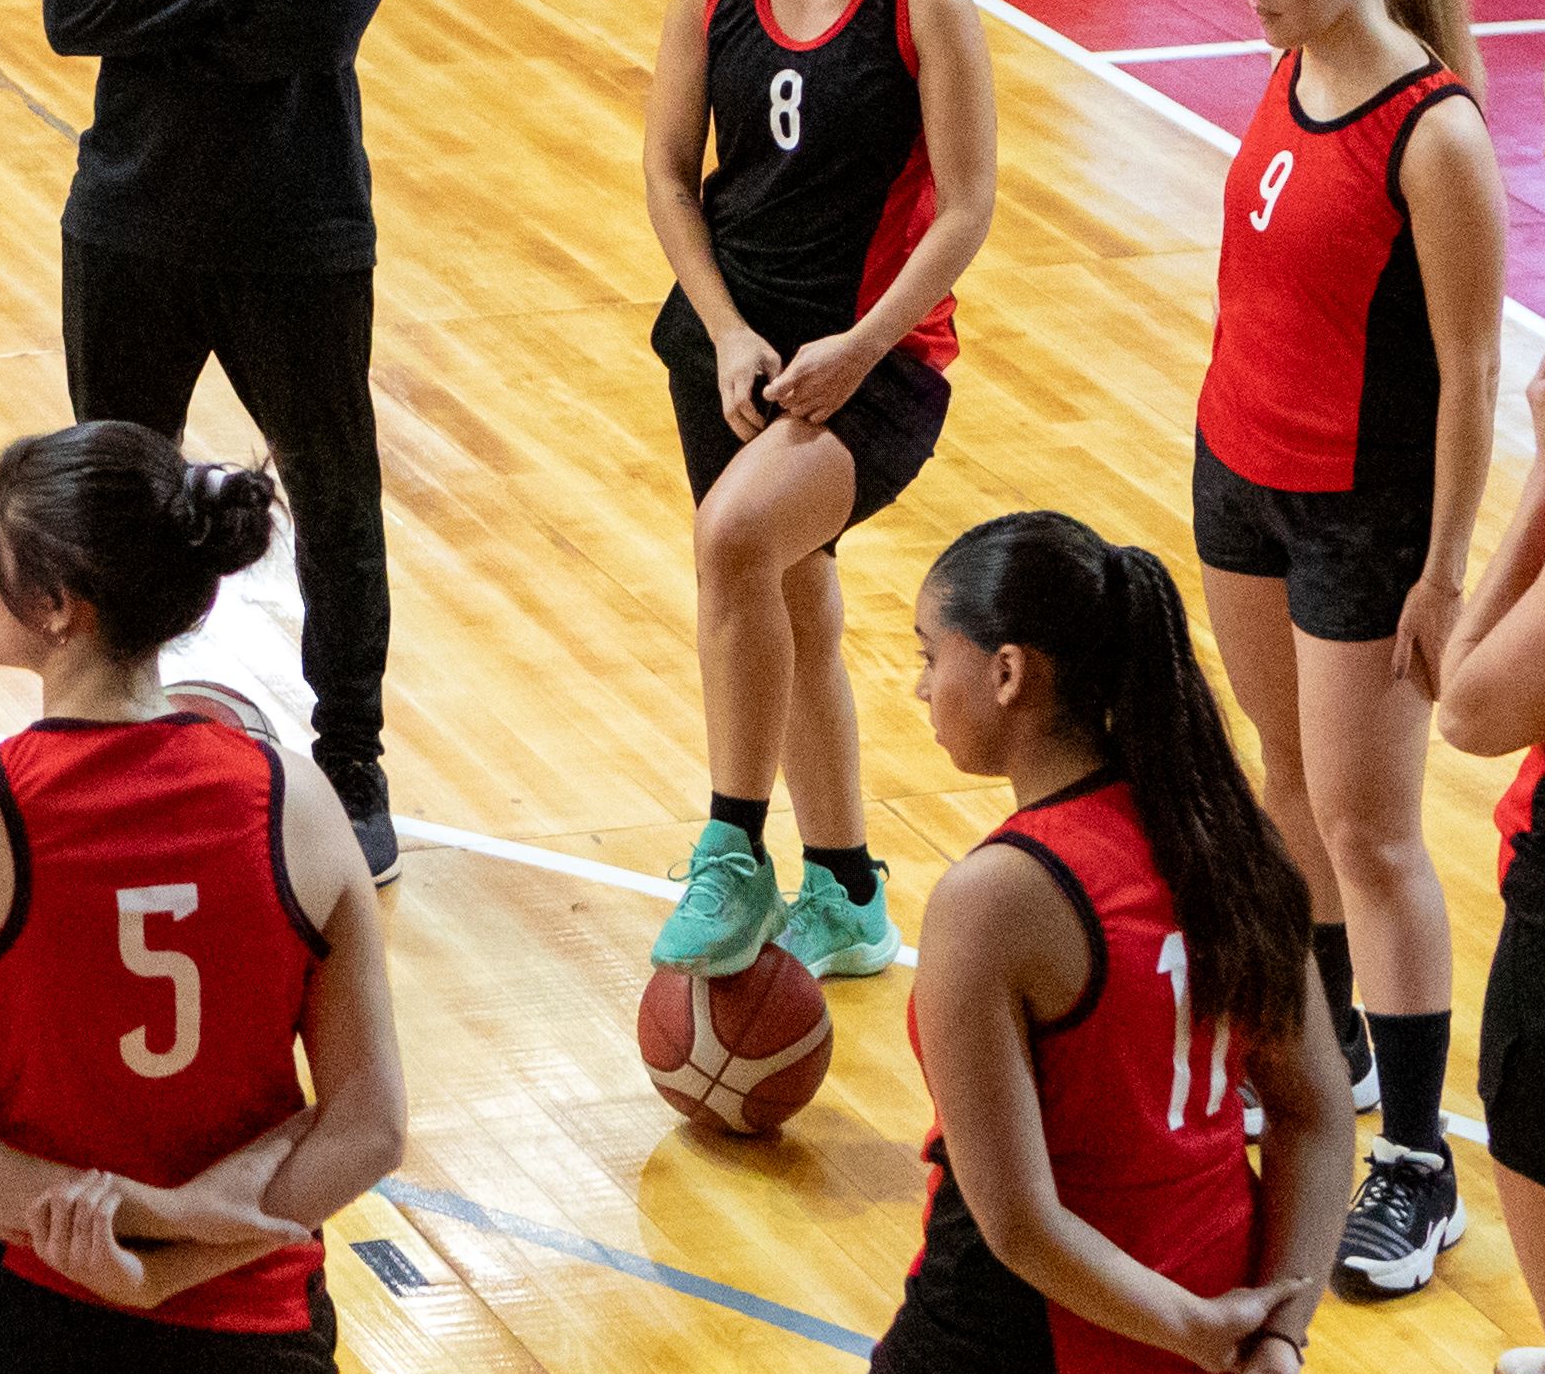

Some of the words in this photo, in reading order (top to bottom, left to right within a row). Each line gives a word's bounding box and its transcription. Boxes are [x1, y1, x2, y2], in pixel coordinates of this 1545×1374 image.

[770, 68, 803, 150] 8
[1249, 149, 1294, 232] 9
[116, 883, 201, 1077] 5
